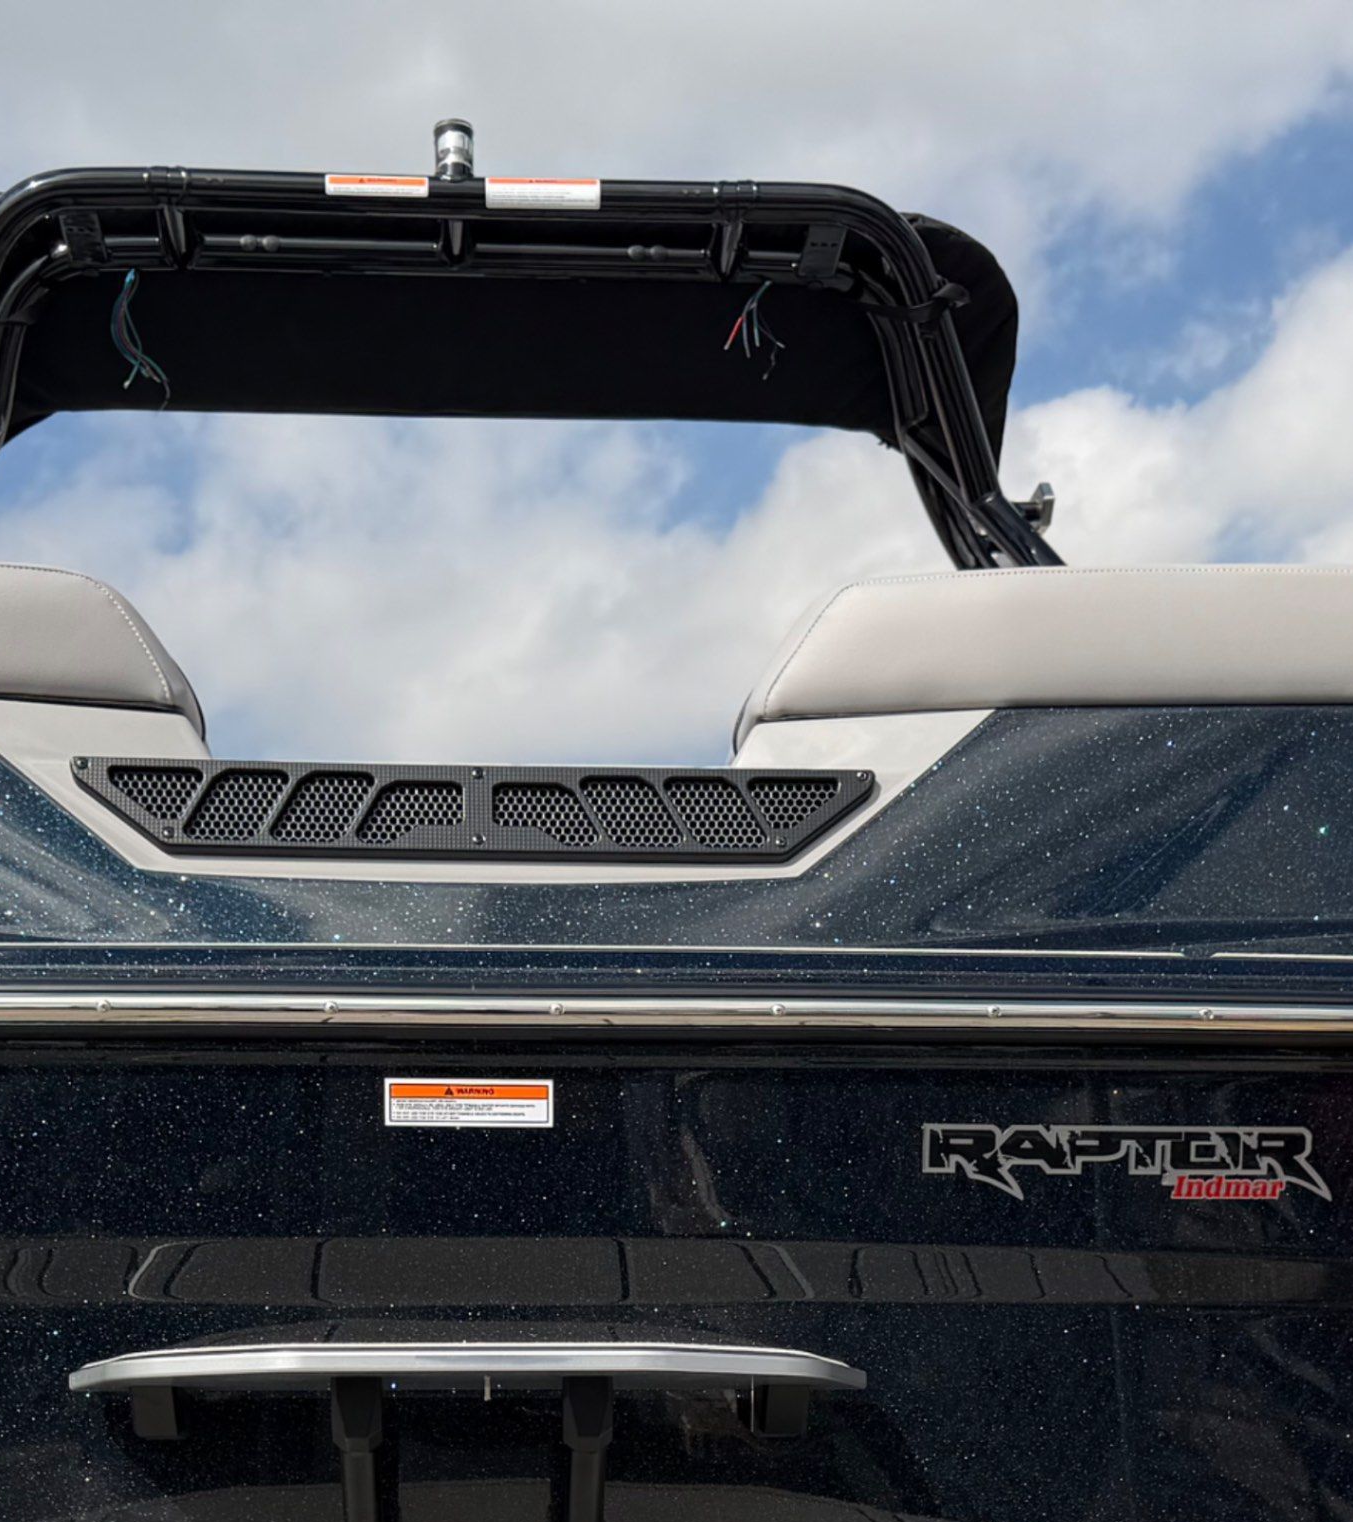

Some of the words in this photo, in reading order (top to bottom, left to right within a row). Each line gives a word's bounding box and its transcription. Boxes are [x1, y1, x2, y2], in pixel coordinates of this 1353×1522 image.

[456, 1087, 495, 1096] WARNING
[921, 1122, 1333, 1201] RAPTOR
[1171, 1174, 1286, 1200] Indmar
